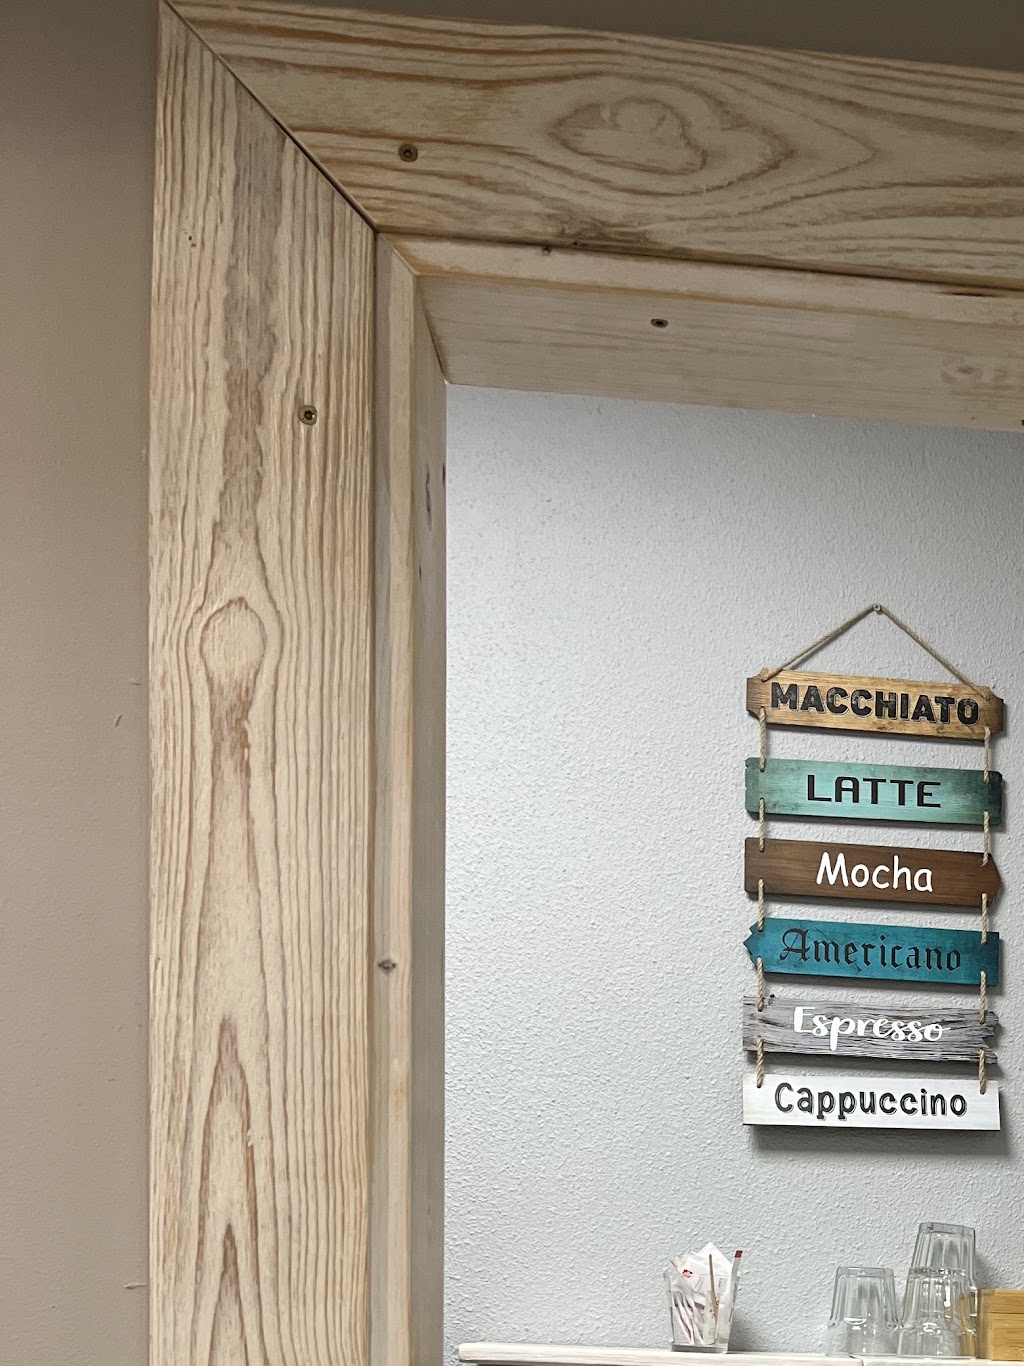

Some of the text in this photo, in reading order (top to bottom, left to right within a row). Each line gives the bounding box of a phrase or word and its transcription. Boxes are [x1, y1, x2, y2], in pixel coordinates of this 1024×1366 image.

[771, 682, 980, 725] MACCHIATO
[807, 774, 942, 808] LATTE
[816, 851, 933, 893] Mocha
[779, 928, 961, 971] Americano
[793, 1006, 950, 1051] Espresso
[774, 1082, 968, 1121] Cappuccino
